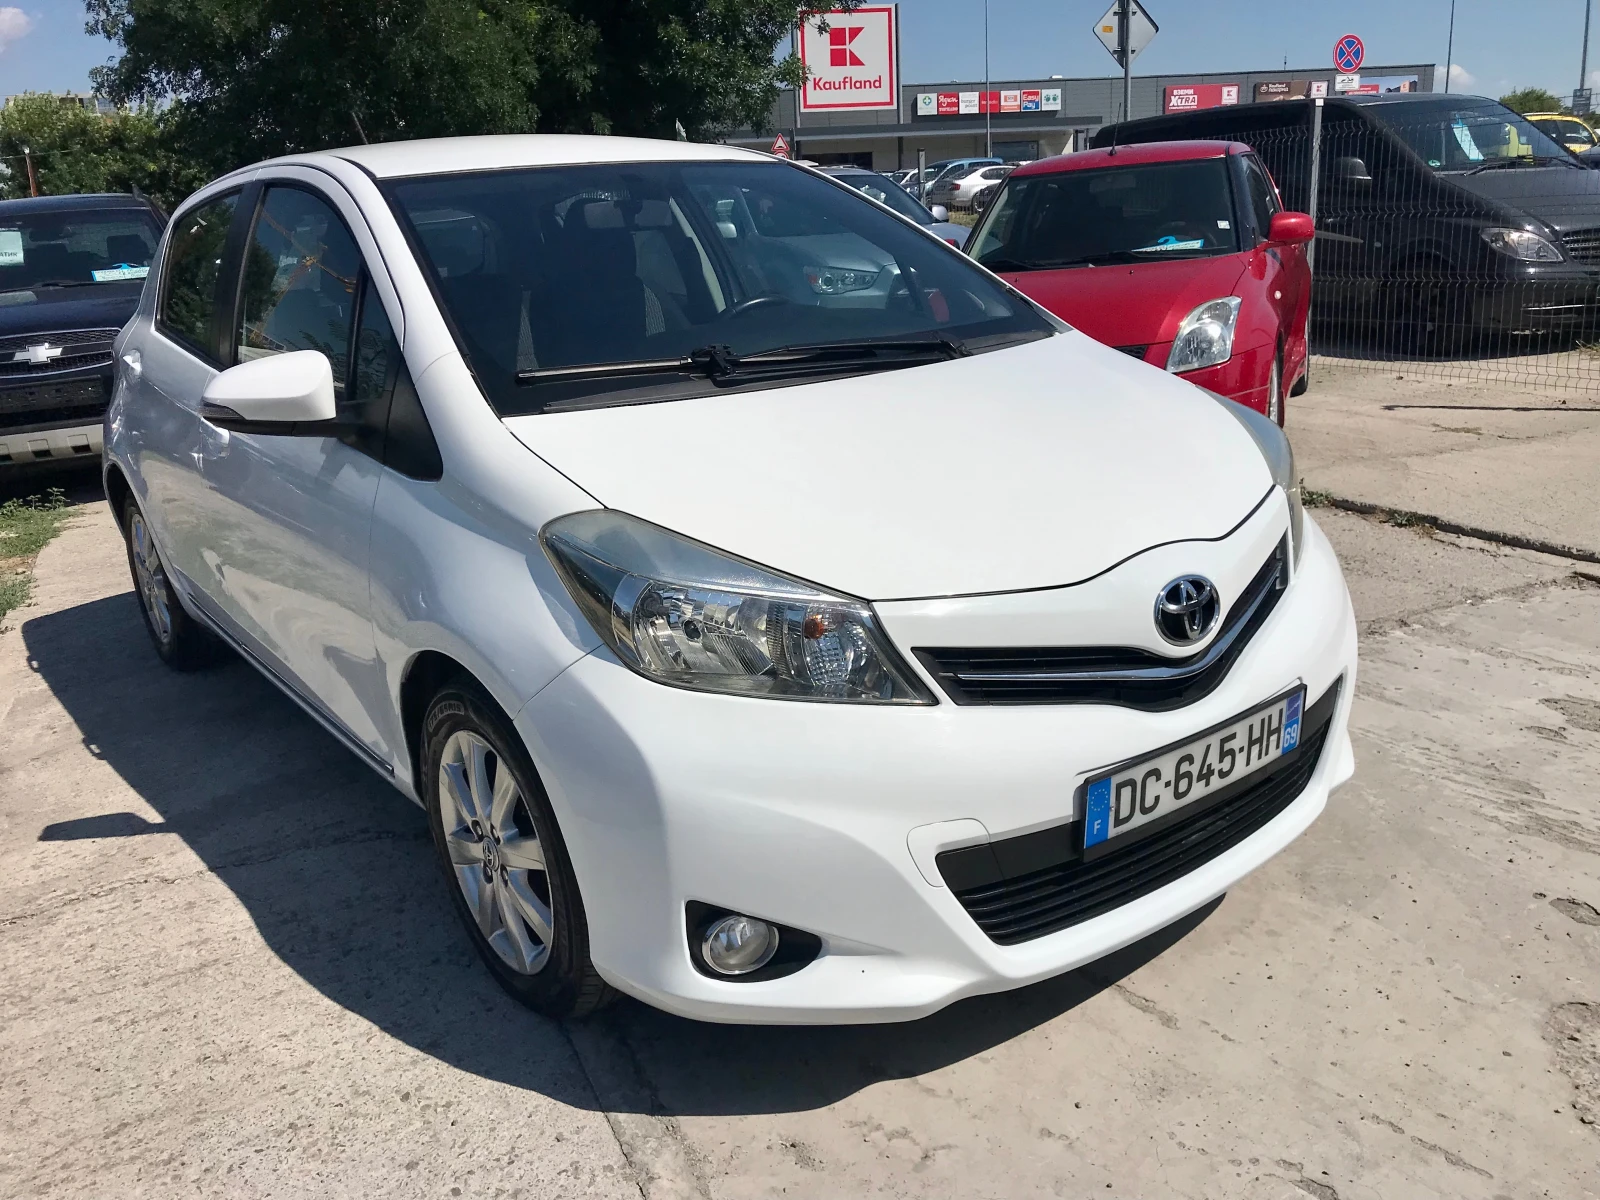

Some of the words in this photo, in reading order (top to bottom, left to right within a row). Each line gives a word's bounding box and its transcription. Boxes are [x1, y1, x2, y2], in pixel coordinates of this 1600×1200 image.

[829, 26, 865, 66] K
[813, 75, 882, 91] Kaufland
[1023, 94, 1039, 102] Easy
[1169, 95, 1197, 106] XTRA
[1023, 102, 1035, 110] Pay
[1284, 723, 1298, 748] 69
[1113, 708, 1284, 829] DC-645-HH
[1093, 820, 1101, 834] F
